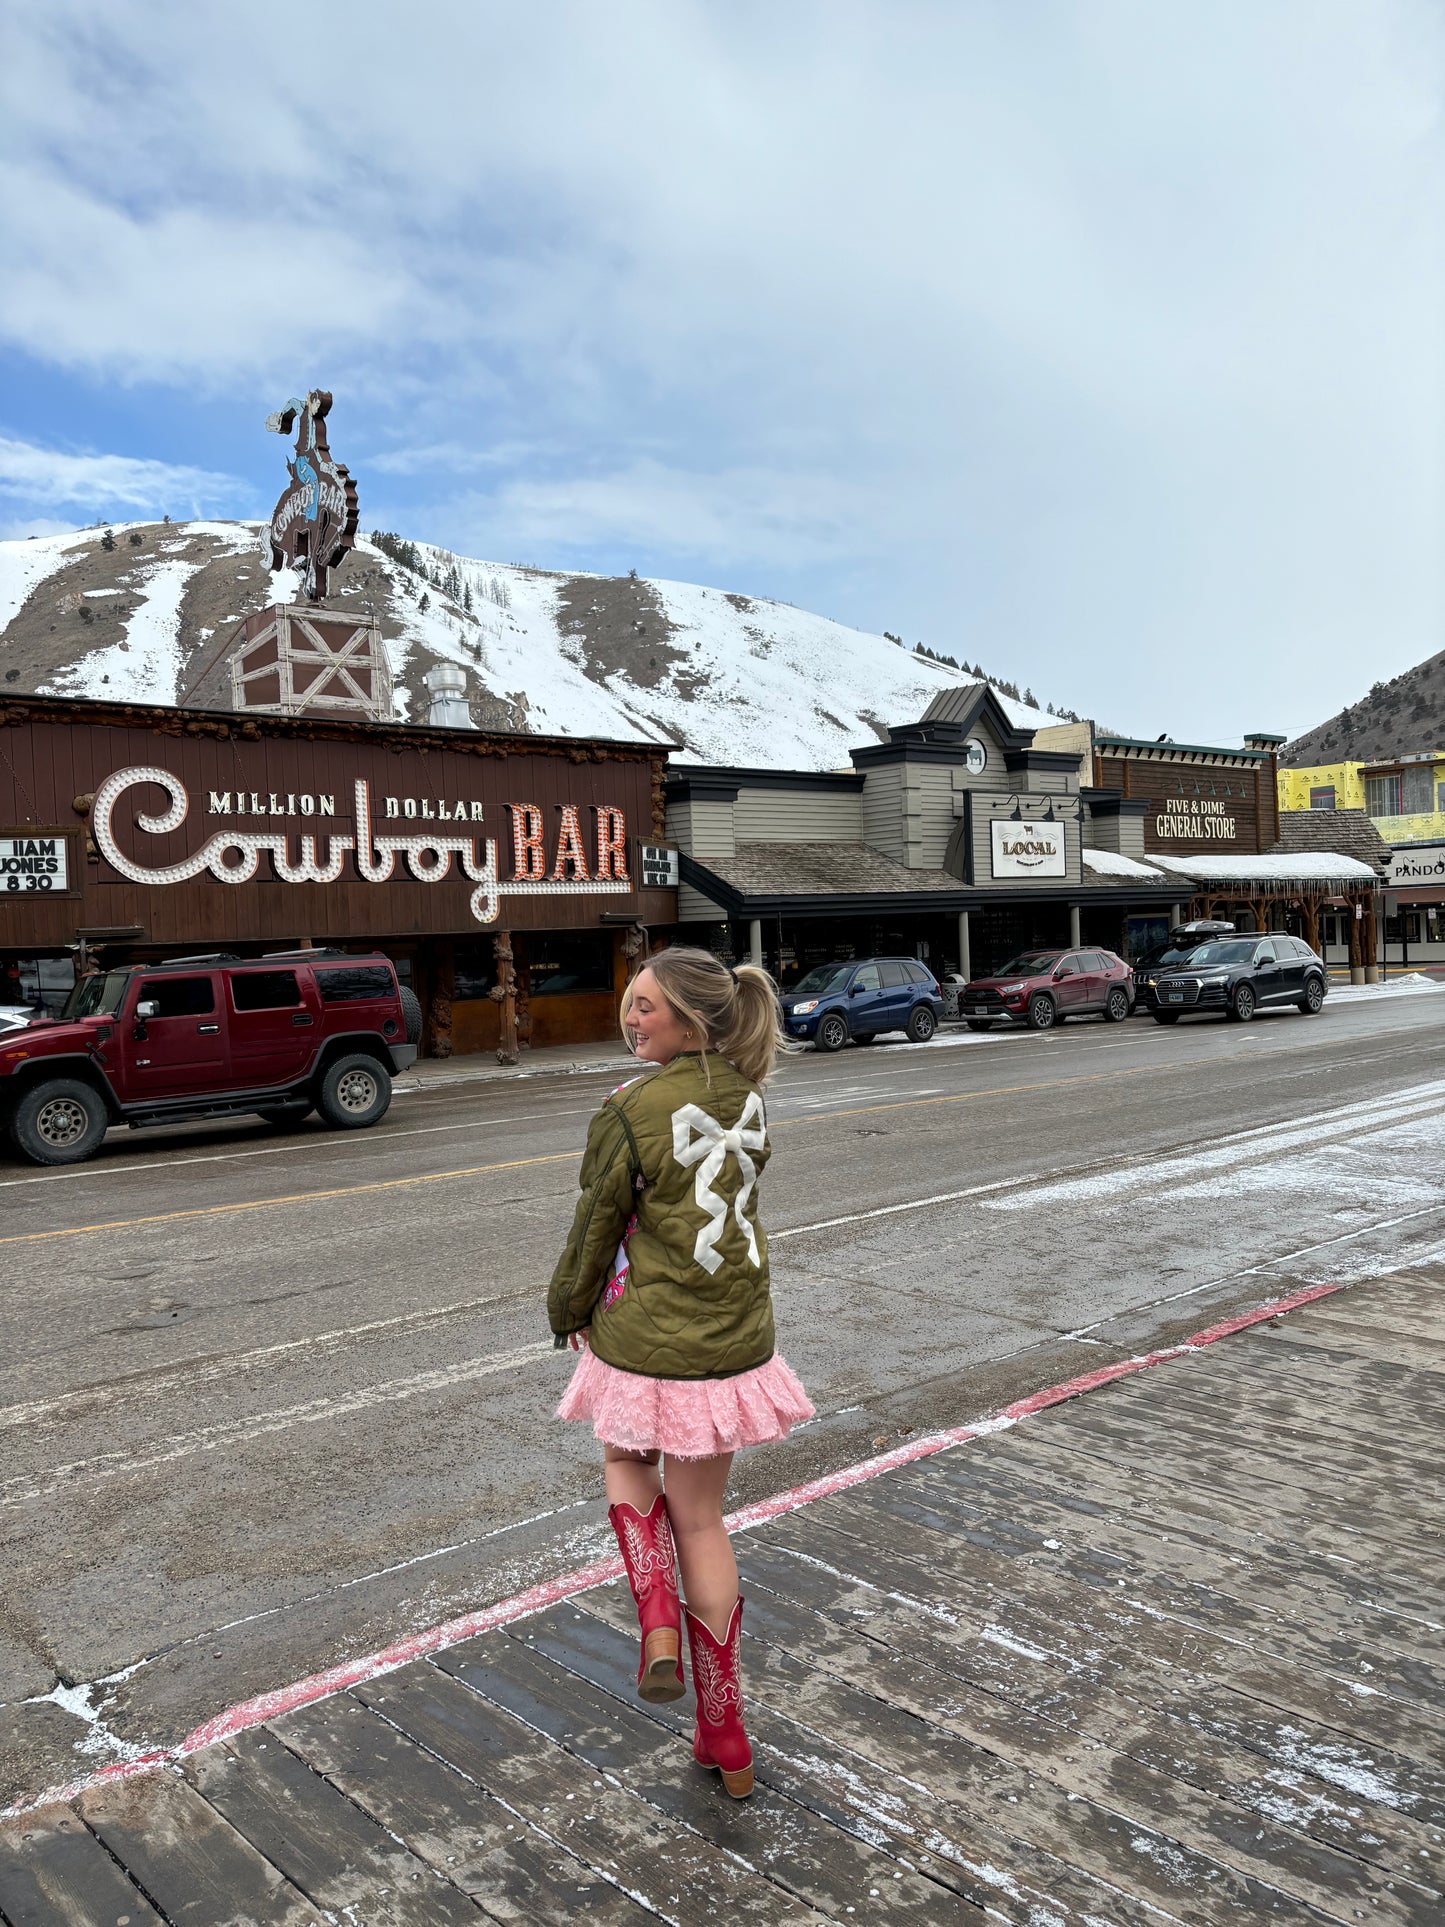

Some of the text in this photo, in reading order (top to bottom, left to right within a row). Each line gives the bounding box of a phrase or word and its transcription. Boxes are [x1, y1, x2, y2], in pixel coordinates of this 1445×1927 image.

[271, 481, 348, 542] COWBOY BAR
[208, 791, 484, 821] MILLION DOLLAR
[1166, 799, 1225, 815] FIVE & DIME
[1156, 815, 1236, 839] GENERAL STORE
[13, 839, 56, 857] 11AM
[94, 765, 632, 924] Cowboy BAR
[1002, 841, 1056, 856] LOCAL
[0, 857, 58, 875] JONES
[1395, 864, 1445, 877] PANDO
[7, 874, 53, 891] 8 30
